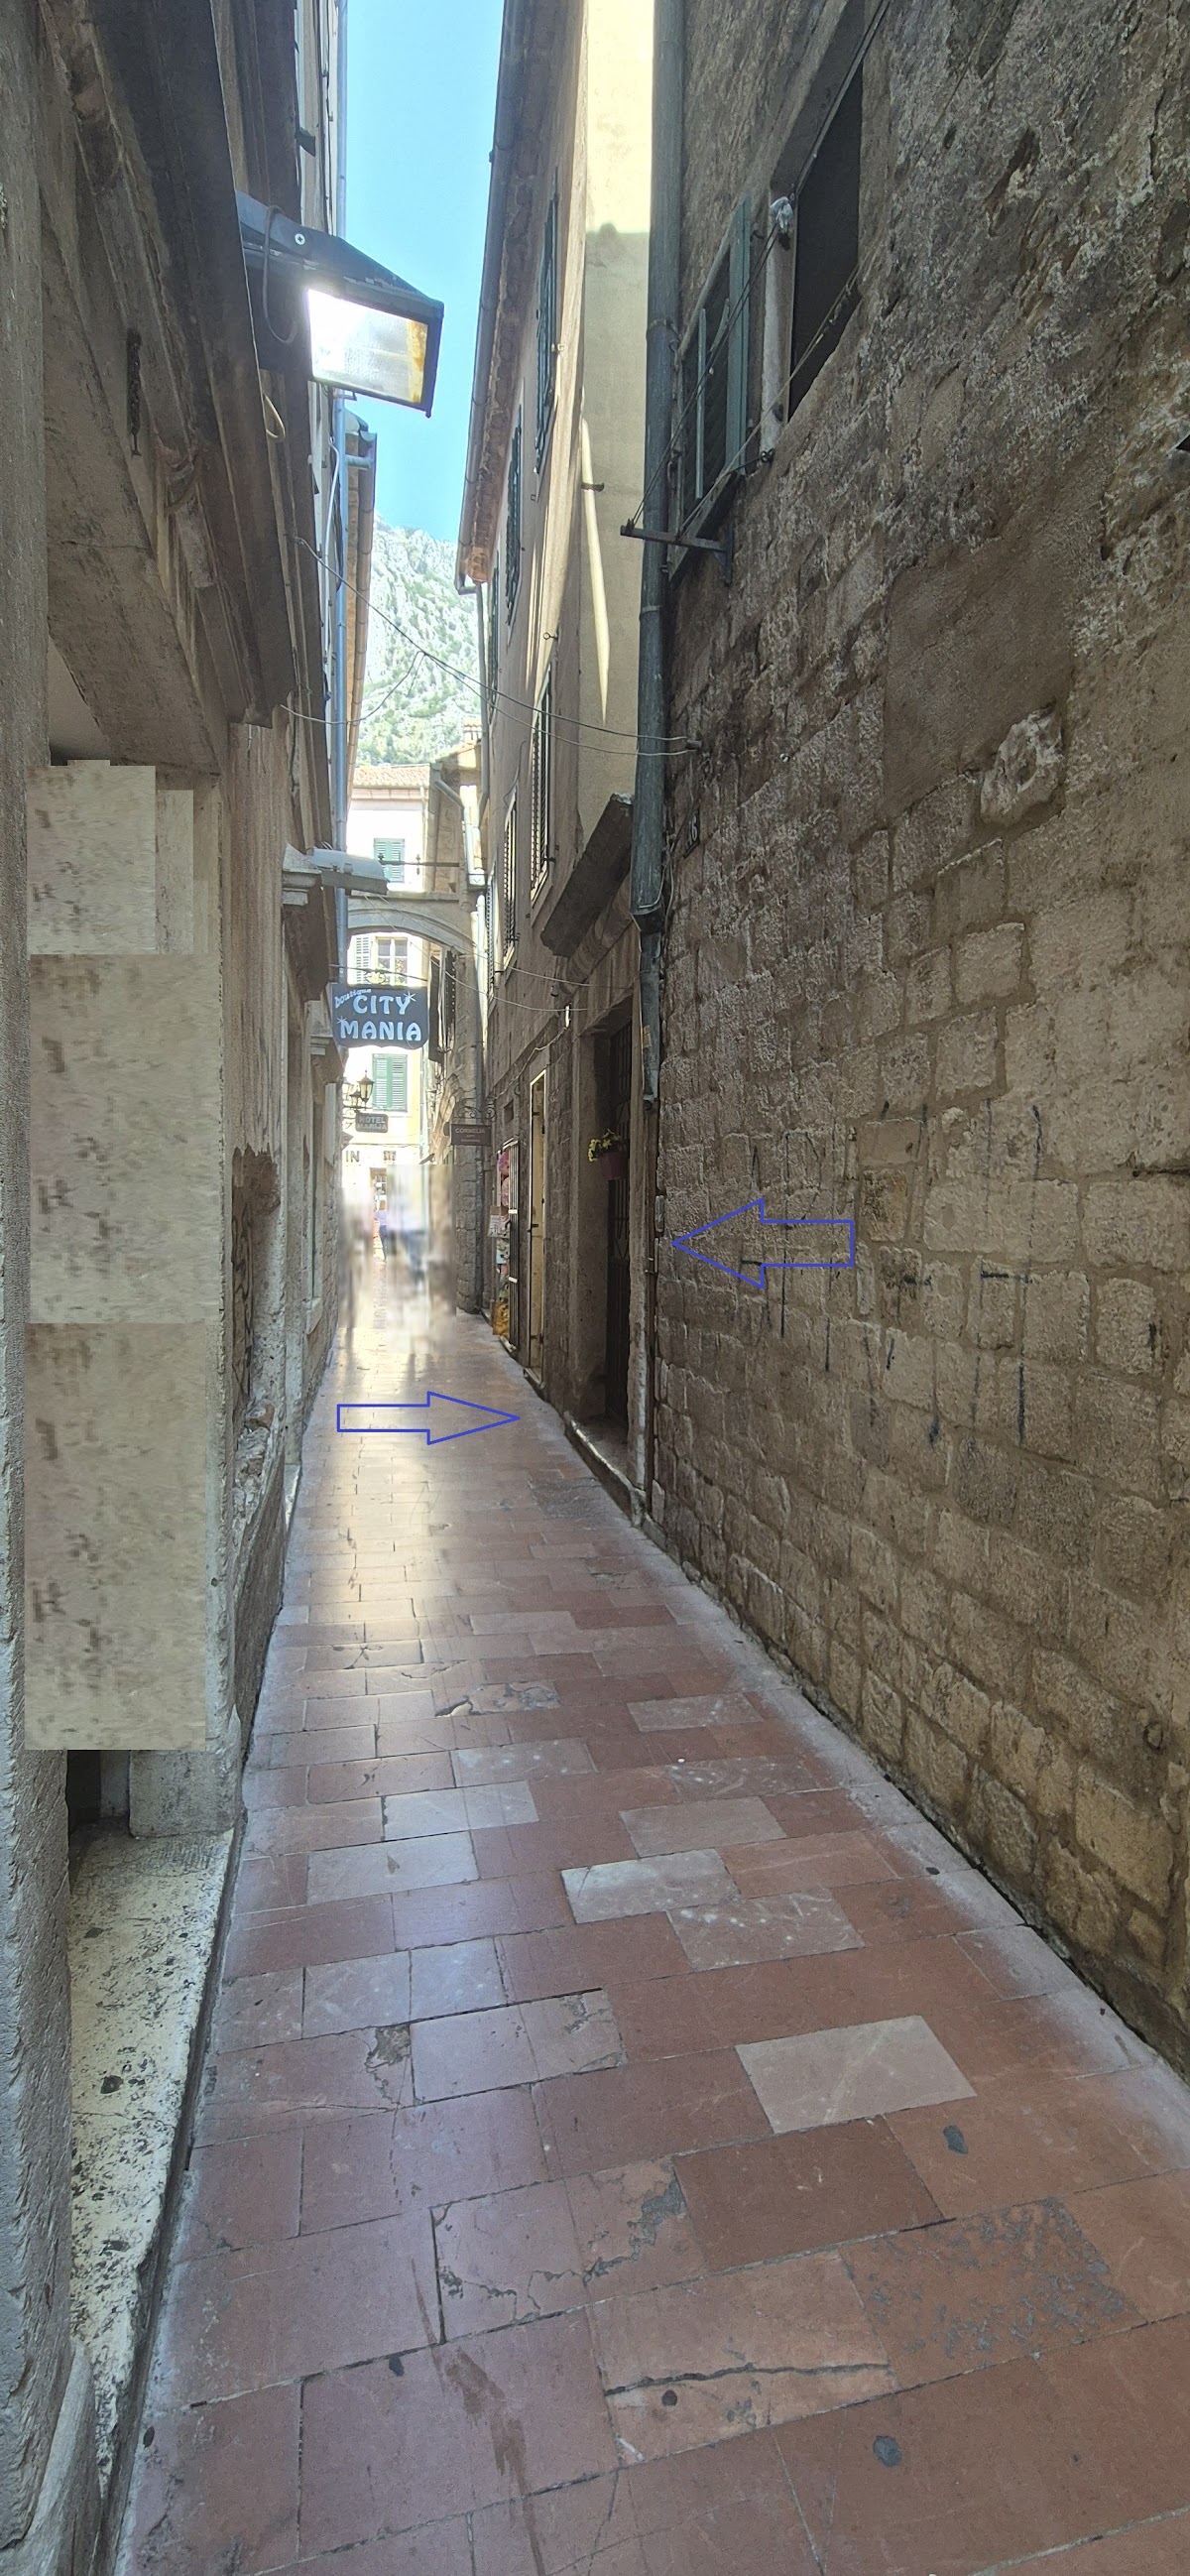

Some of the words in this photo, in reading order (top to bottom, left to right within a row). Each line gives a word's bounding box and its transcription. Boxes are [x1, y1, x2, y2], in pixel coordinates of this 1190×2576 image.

[334, 989, 372, 1009] boutique
[353, 995, 412, 1015] CITY
[340, 1020, 421, 1042] MANIA
